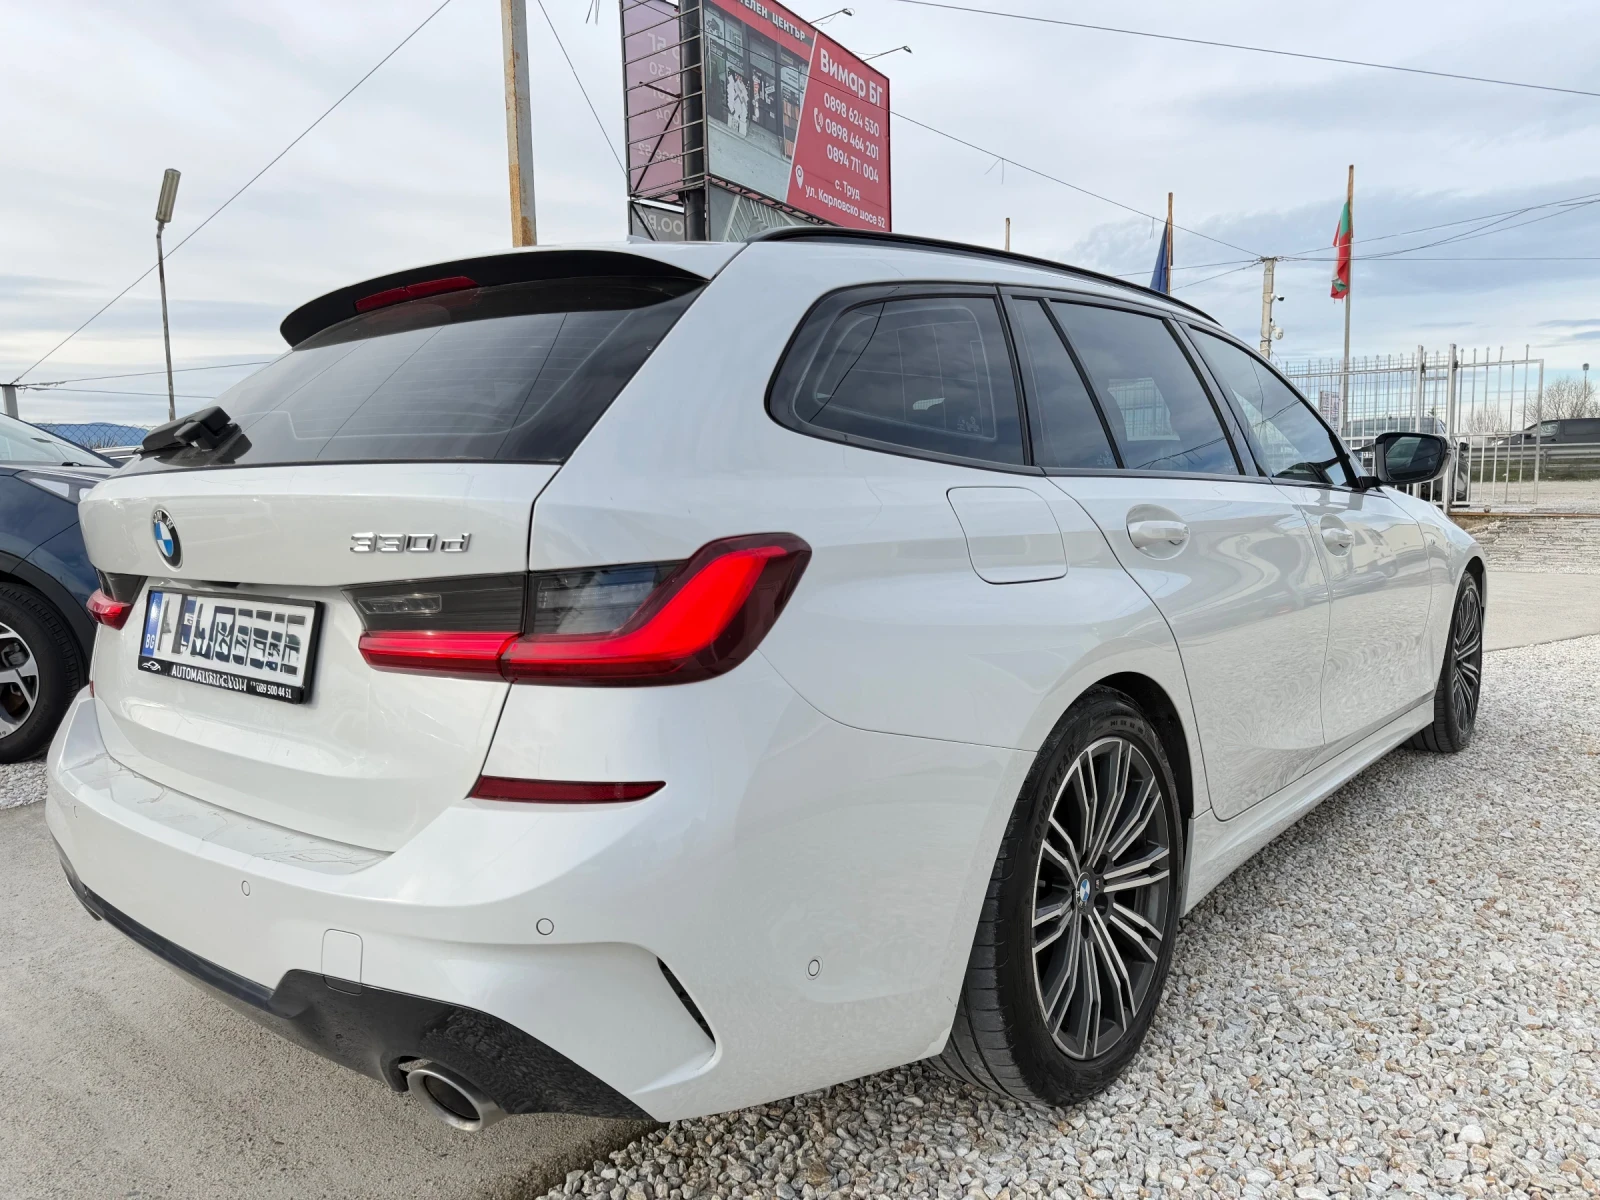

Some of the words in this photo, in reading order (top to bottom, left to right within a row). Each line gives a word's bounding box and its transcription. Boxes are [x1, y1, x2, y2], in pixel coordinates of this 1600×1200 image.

[740, 0, 768, 19] ЕЛЕН
[772, 12, 806, 41] ЦЕНТЪР
[820, 48, 866, 98] Вимар
[869, 80, 883, 106] БГ
[824, 92, 847, 118] 0898
[848, 107, 863, 129] 624
[864, 117, 880, 137] 530
[825, 118, 848, 143] 0898
[849, 132, 865, 153] 464
[865, 141, 879, 160] 201
[826, 144, 849, 168] 0894
[850, 156, 862, 174] 711
[863, 163, 879, 183] 004
[804, 184, 817, 198] ул.
[818, 188, 859, 217] Карловско
[859, 210, 877, 224] шосе
[877, 215, 886, 229] 52
[834, 179, 842, 191] с.
[842, 181, 860, 201] Труд
[350, 531, 472, 553] 330d
[145, 634, 155, 649] BG
[267, 685, 278, 696] 500
[278, 687, 285, 697] 44
[1031, 743, 1076, 856] GOODYEAR
